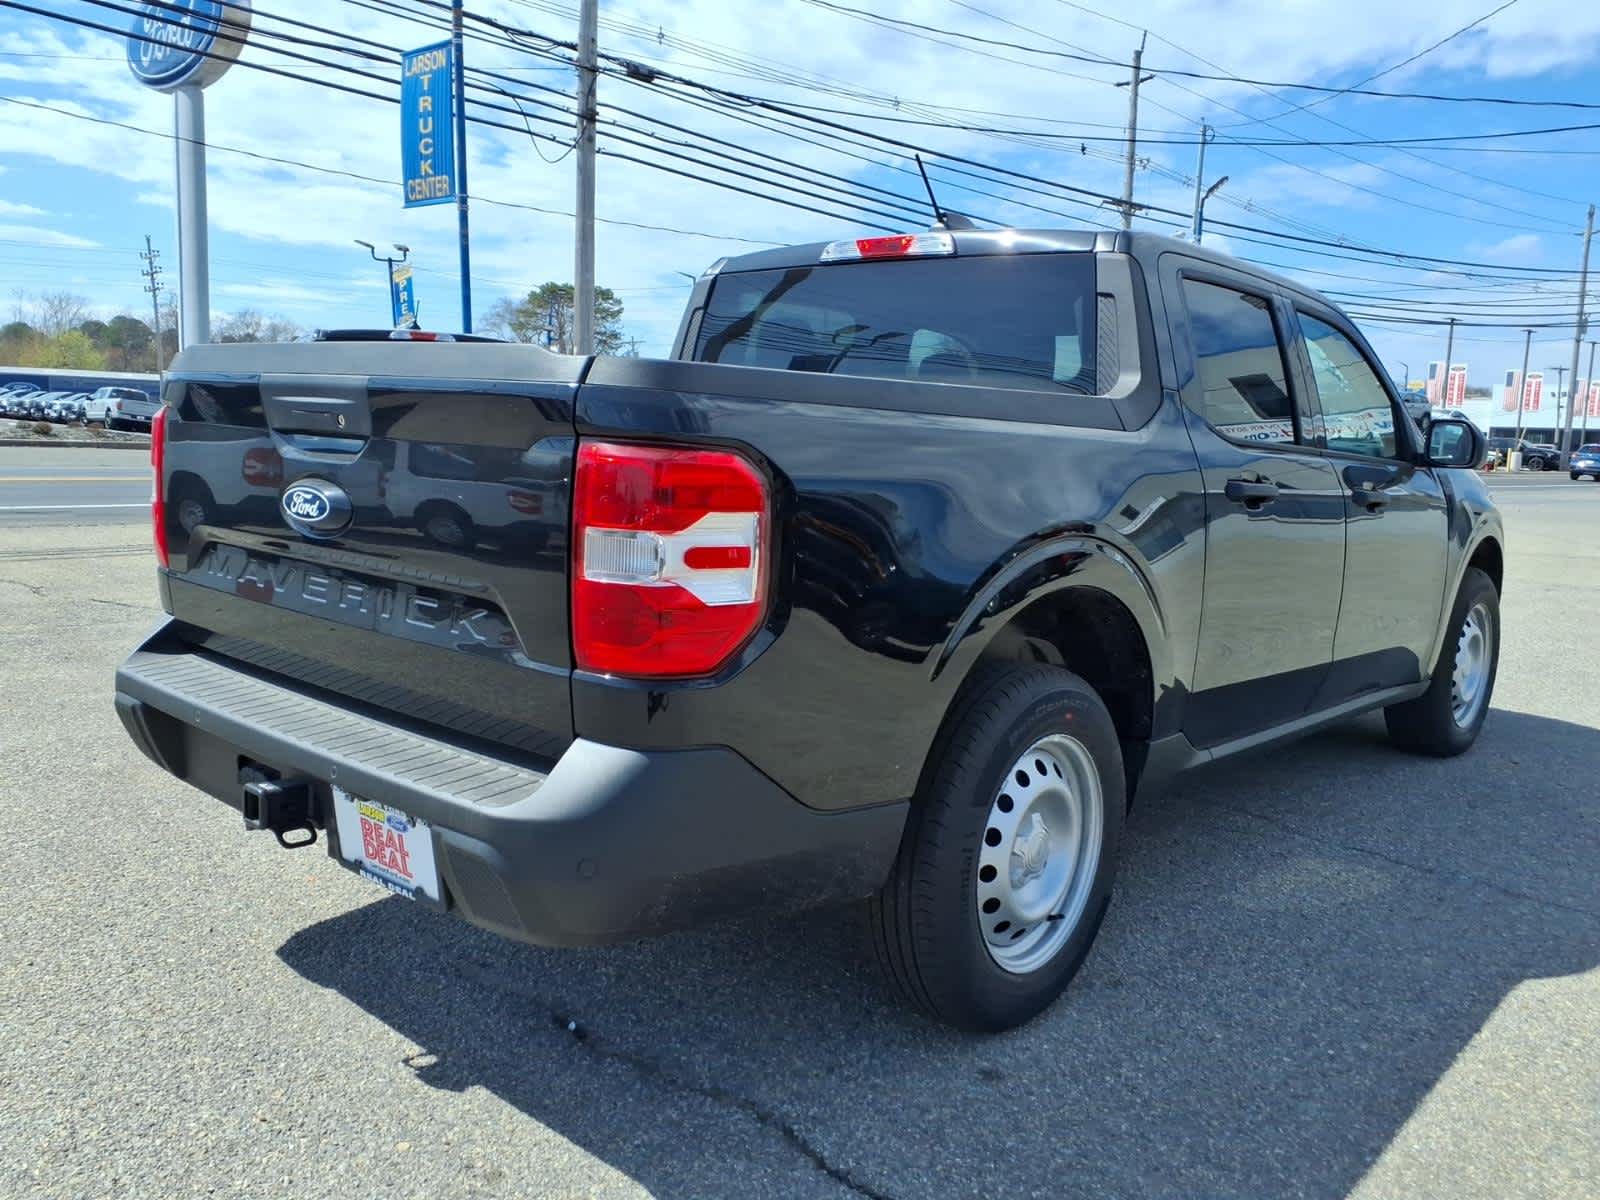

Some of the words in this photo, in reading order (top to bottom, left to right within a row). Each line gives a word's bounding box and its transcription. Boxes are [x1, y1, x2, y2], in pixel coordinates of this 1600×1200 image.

[405, 48, 446, 77] LARSON
[419, 74, 433, 176] TRUCK
[408, 175, 449, 200] CENTER
[291, 492, 320, 517] Ford
[207, 549, 488, 641] MAVERICK
[360, 817, 409, 857] REAL
[364, 840, 413, 879] DEAL
